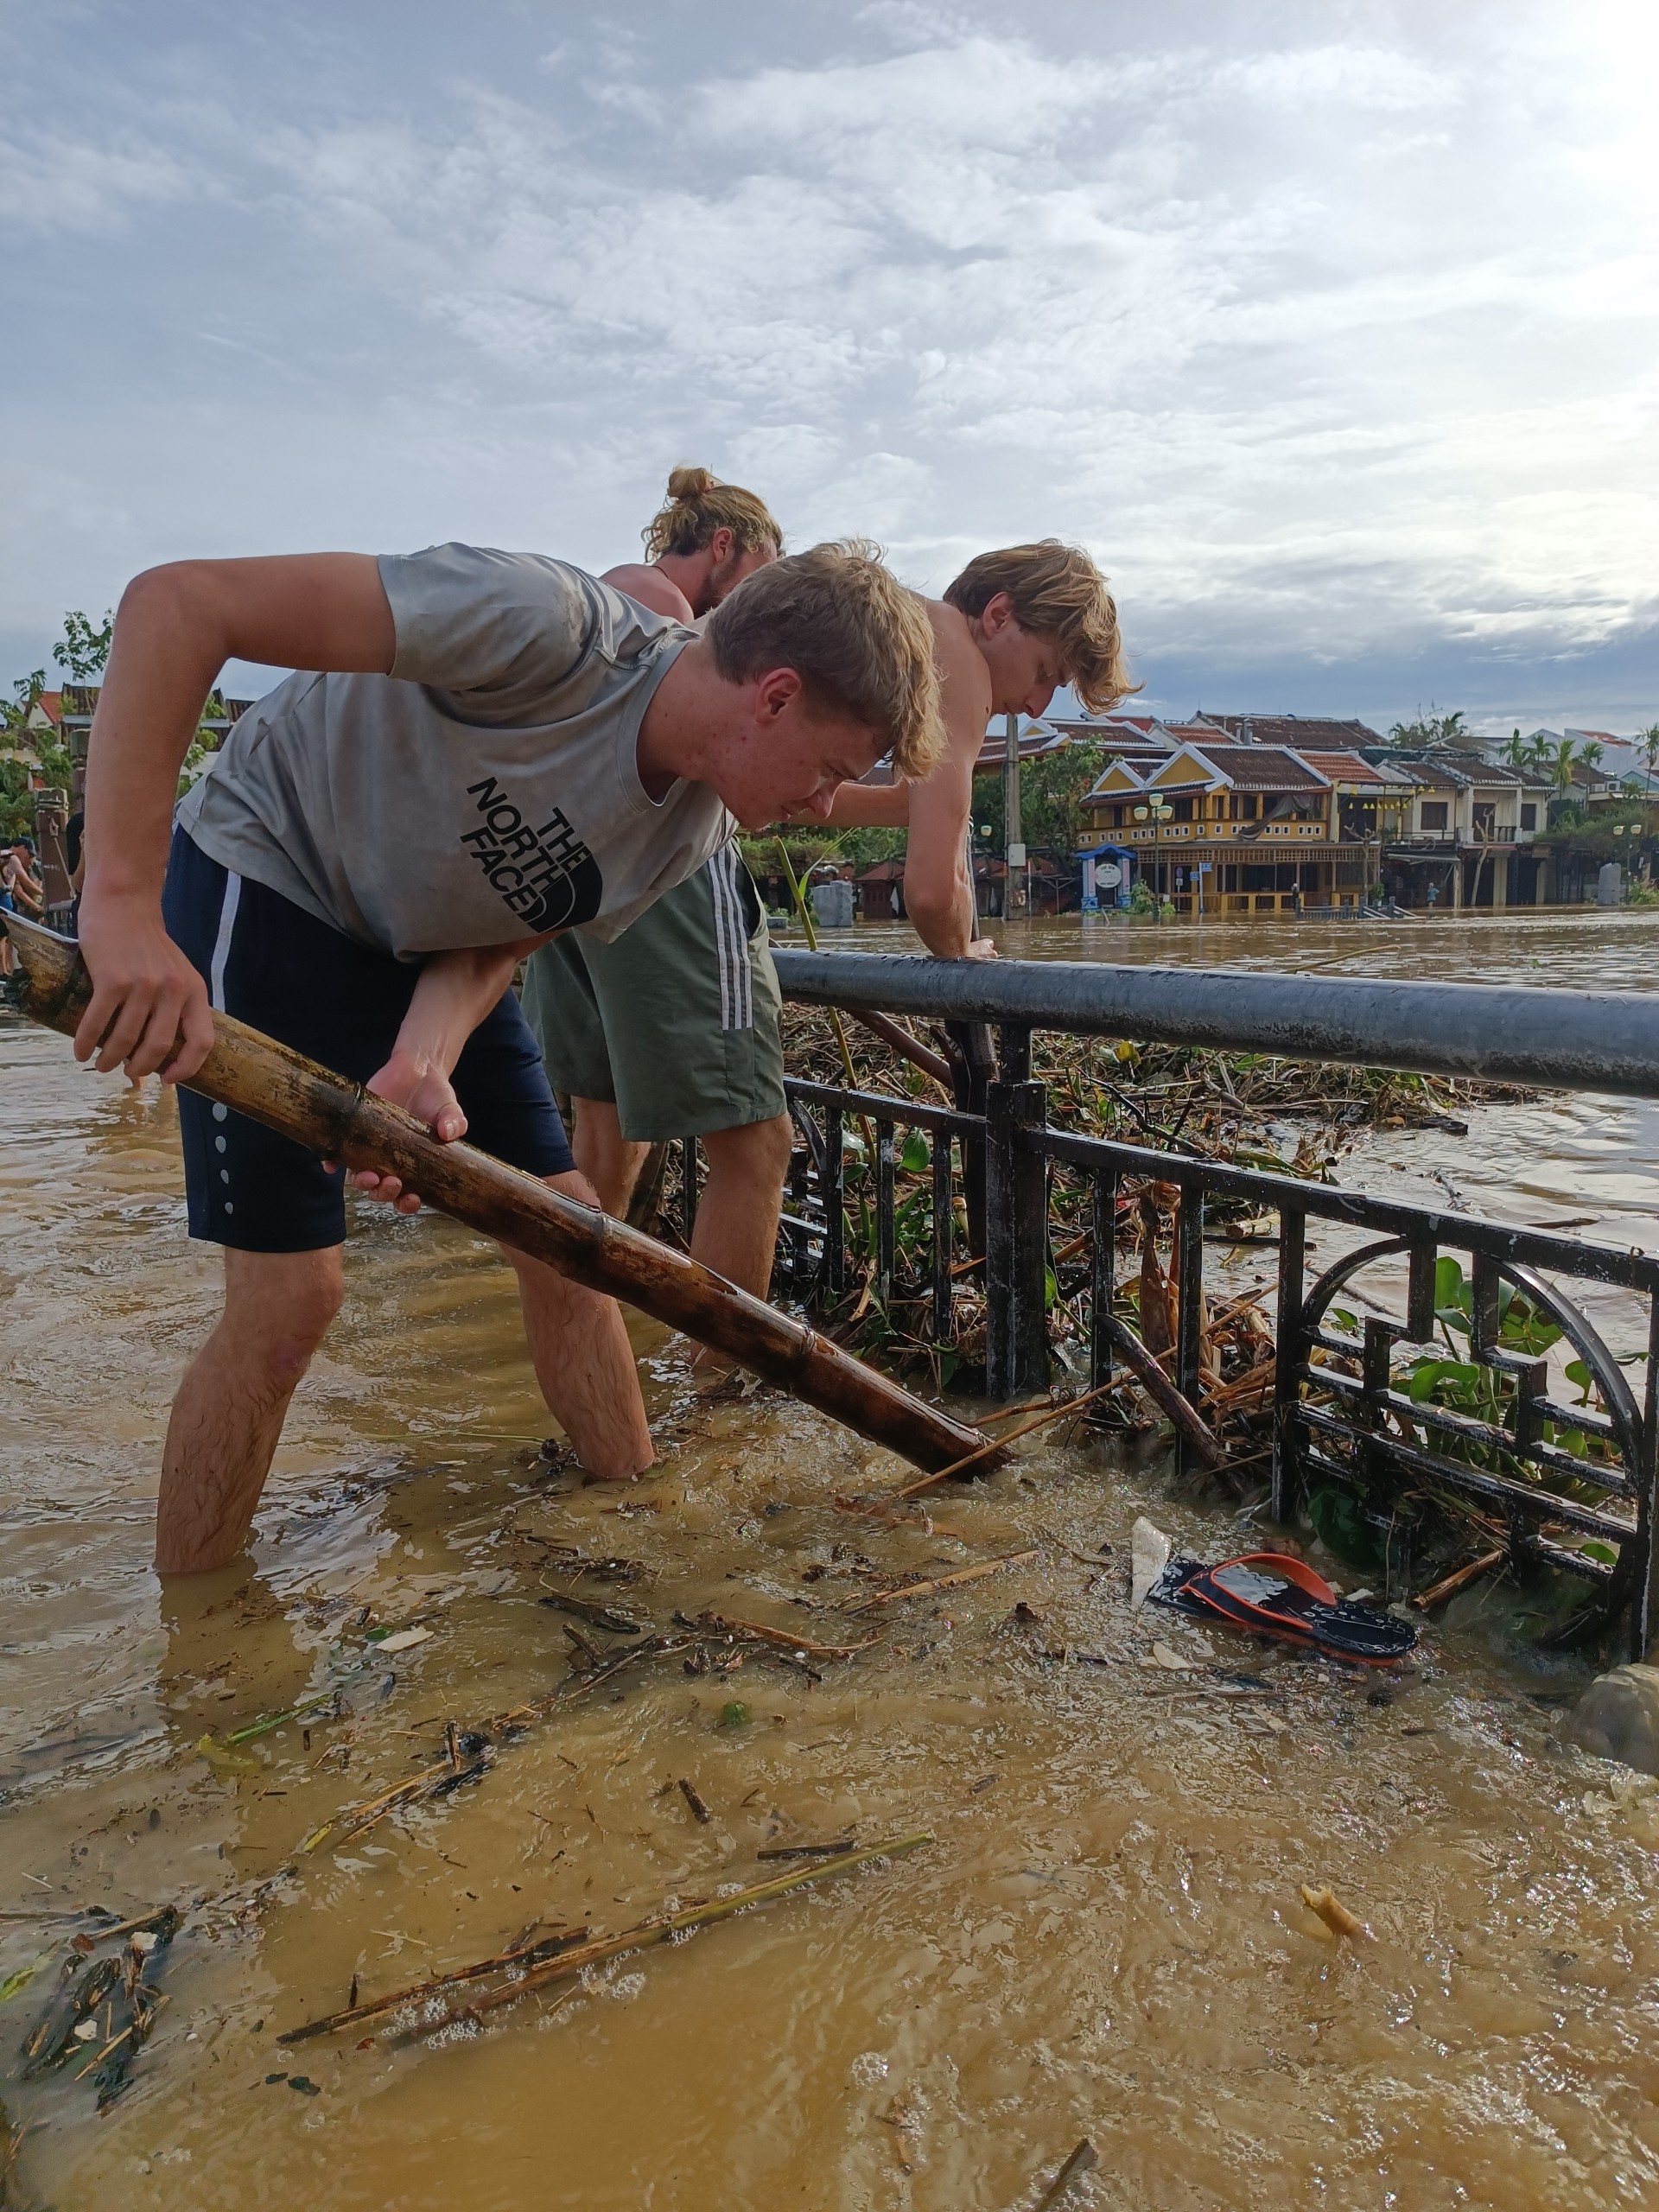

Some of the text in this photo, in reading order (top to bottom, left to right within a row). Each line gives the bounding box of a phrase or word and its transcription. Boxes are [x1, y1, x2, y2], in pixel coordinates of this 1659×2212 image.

[459, 825, 539, 912] FACE
[466, 776, 566, 894] NORTH
[536, 806, 593, 873] THE
